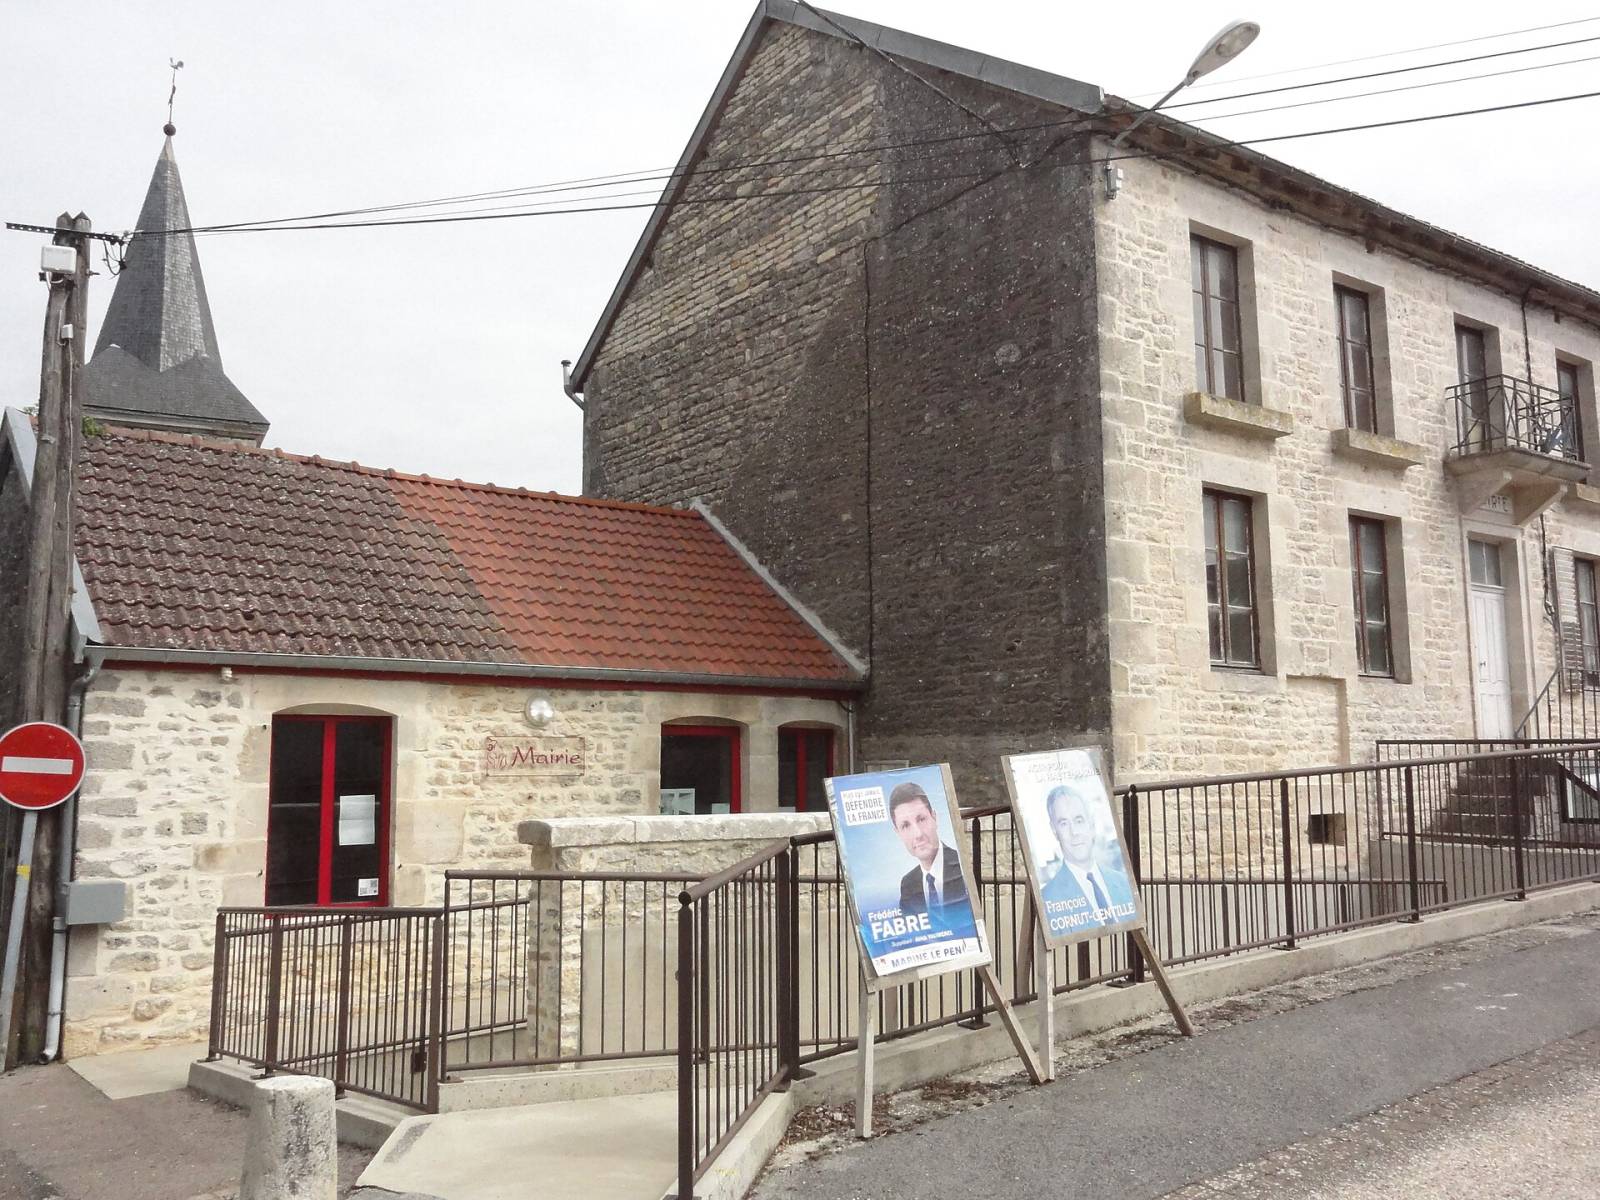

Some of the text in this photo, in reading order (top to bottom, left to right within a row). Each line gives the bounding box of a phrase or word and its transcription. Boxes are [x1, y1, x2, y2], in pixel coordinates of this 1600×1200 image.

[511, 745, 581, 767] Mairie
[847, 808, 885, 823] LA FRANCE
[868, 907, 903, 921] Frédéric
[1045, 896, 1087, 914] François
[871, 912, 931, 940] FABRE
[1050, 902, 1136, 931] CORNUT-GENTILLE
[891, 946, 962, 969] MARINE LE PEN
